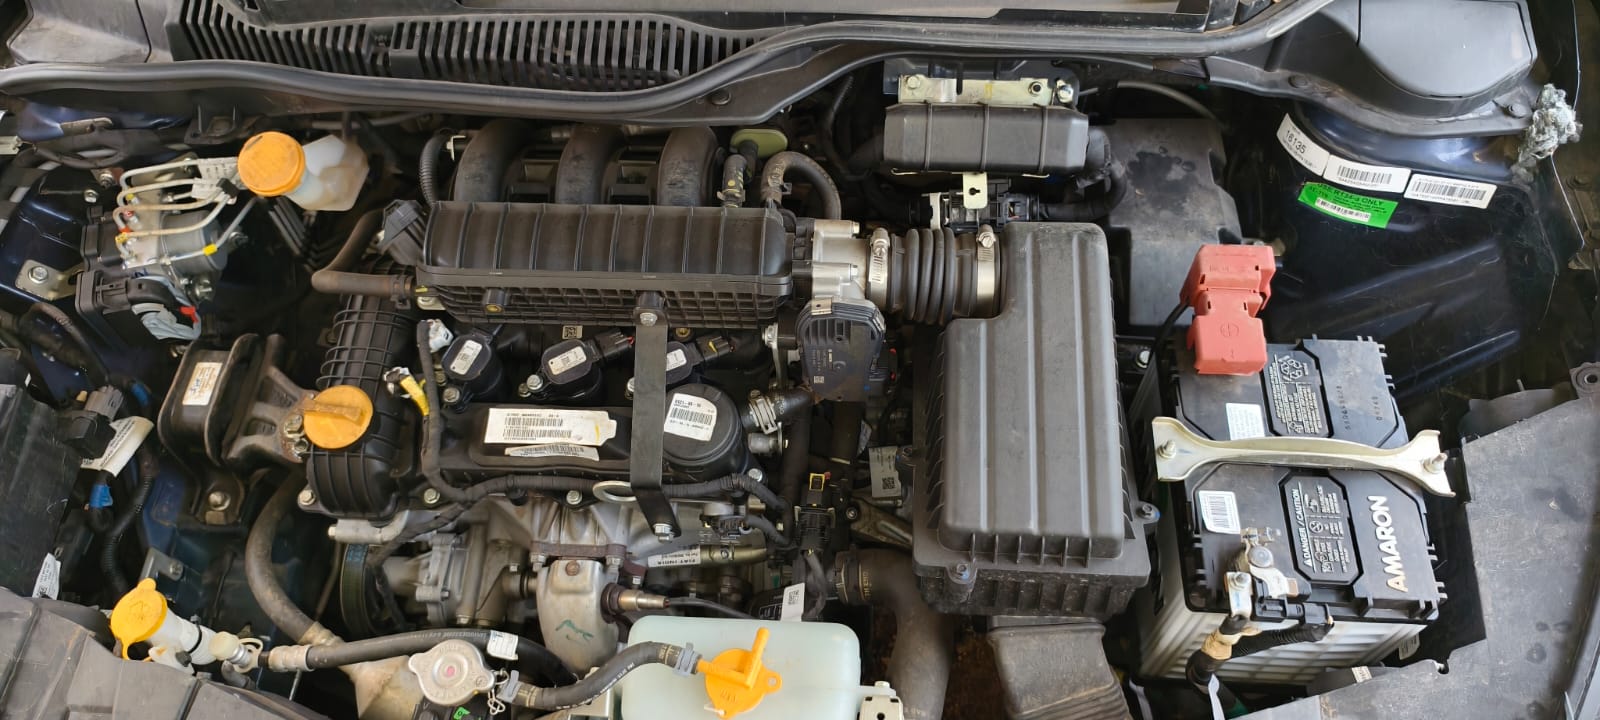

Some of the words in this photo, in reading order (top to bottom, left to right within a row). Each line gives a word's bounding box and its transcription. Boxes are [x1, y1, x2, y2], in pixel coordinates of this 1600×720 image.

[1286, 130, 1307, 154] 16135
[1361, 197, 1385, 206] ONLY
[1292, 488, 1304, 520] CAUTION
[1299, 527, 1312, 560] DANGER
[1367, 495, 1409, 593] AMARON
